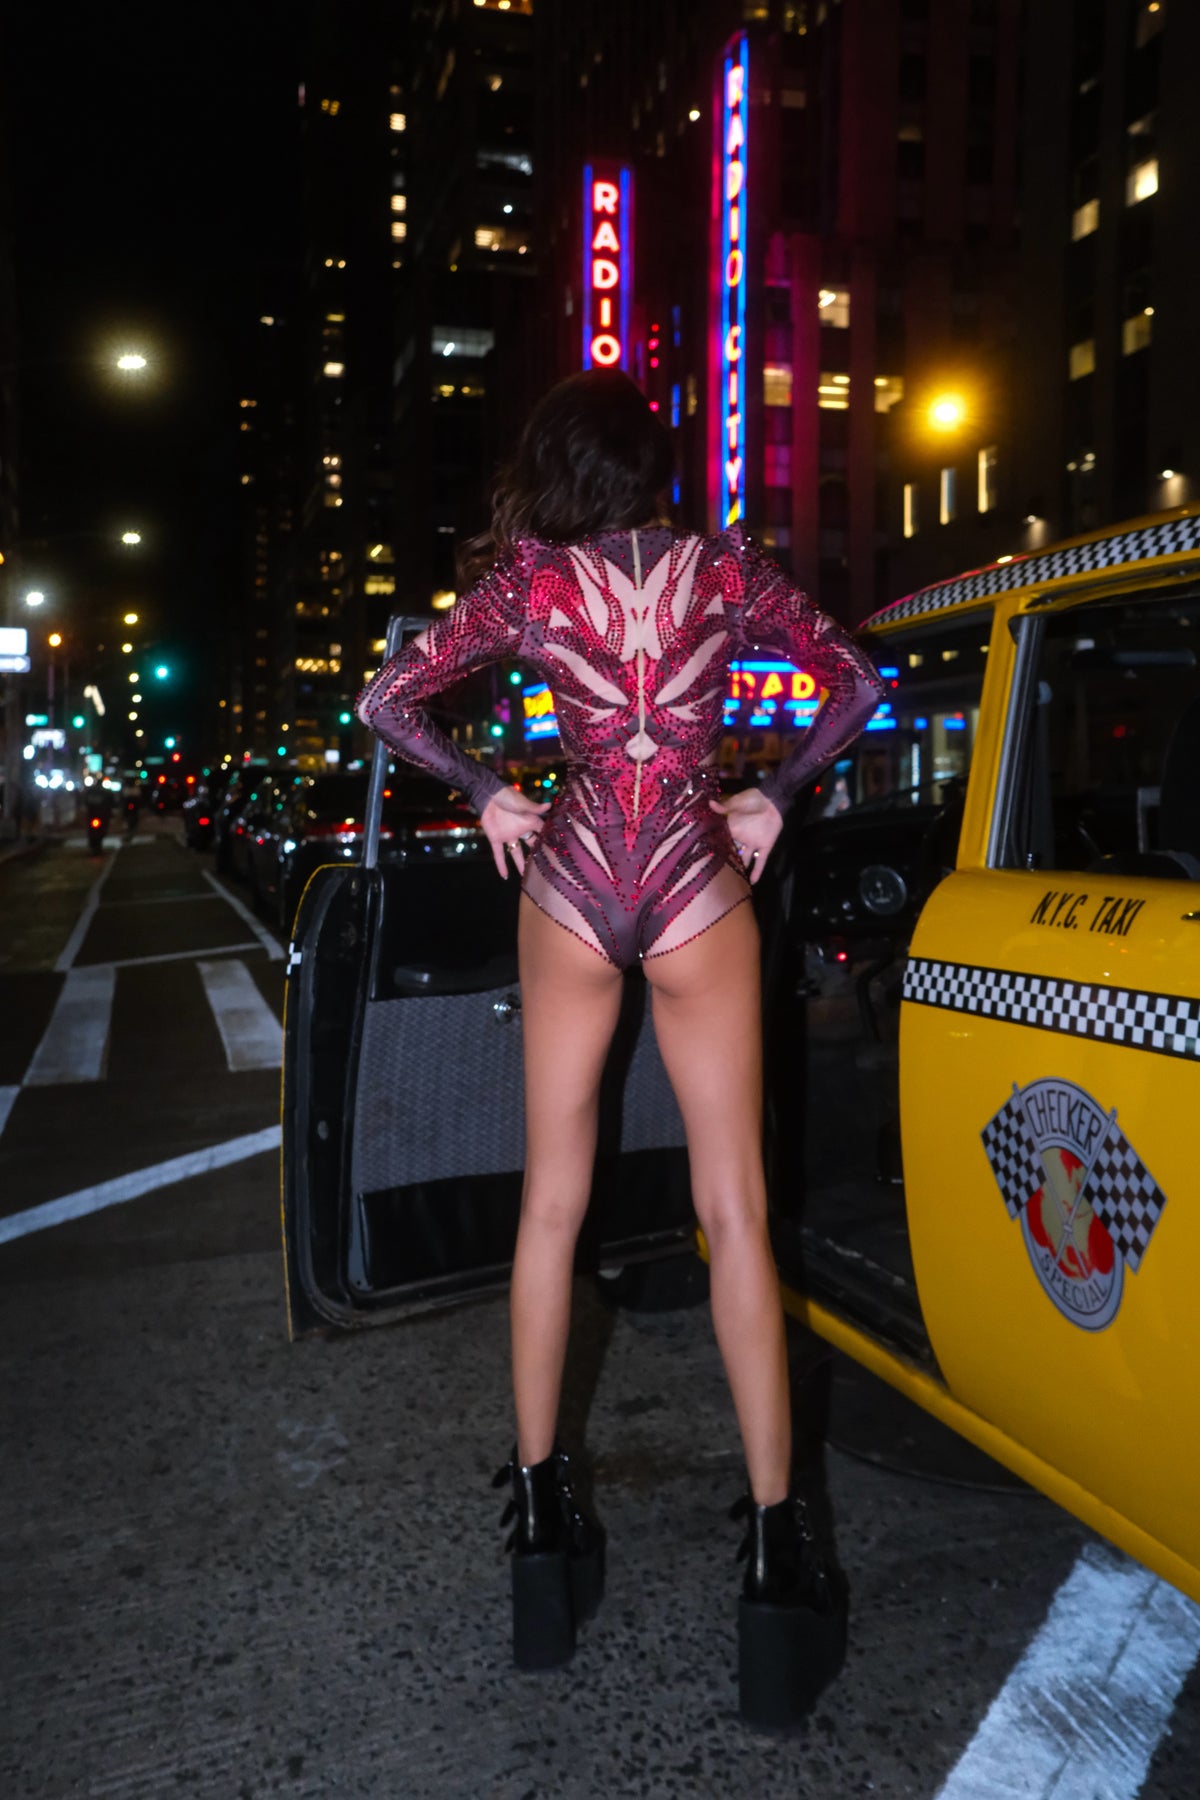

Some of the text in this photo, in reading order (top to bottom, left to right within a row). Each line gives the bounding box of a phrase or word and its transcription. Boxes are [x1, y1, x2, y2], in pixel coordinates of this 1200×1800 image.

[591, 181, 621, 366] RADIO
[725, 64, 745, 494] RADIO CITY
[1030, 891, 1146, 936] N.Y.C. TAXI
[1025, 1089, 1102, 1156] CHECKER
[1041, 1253, 1108, 1310] SPECIAL
